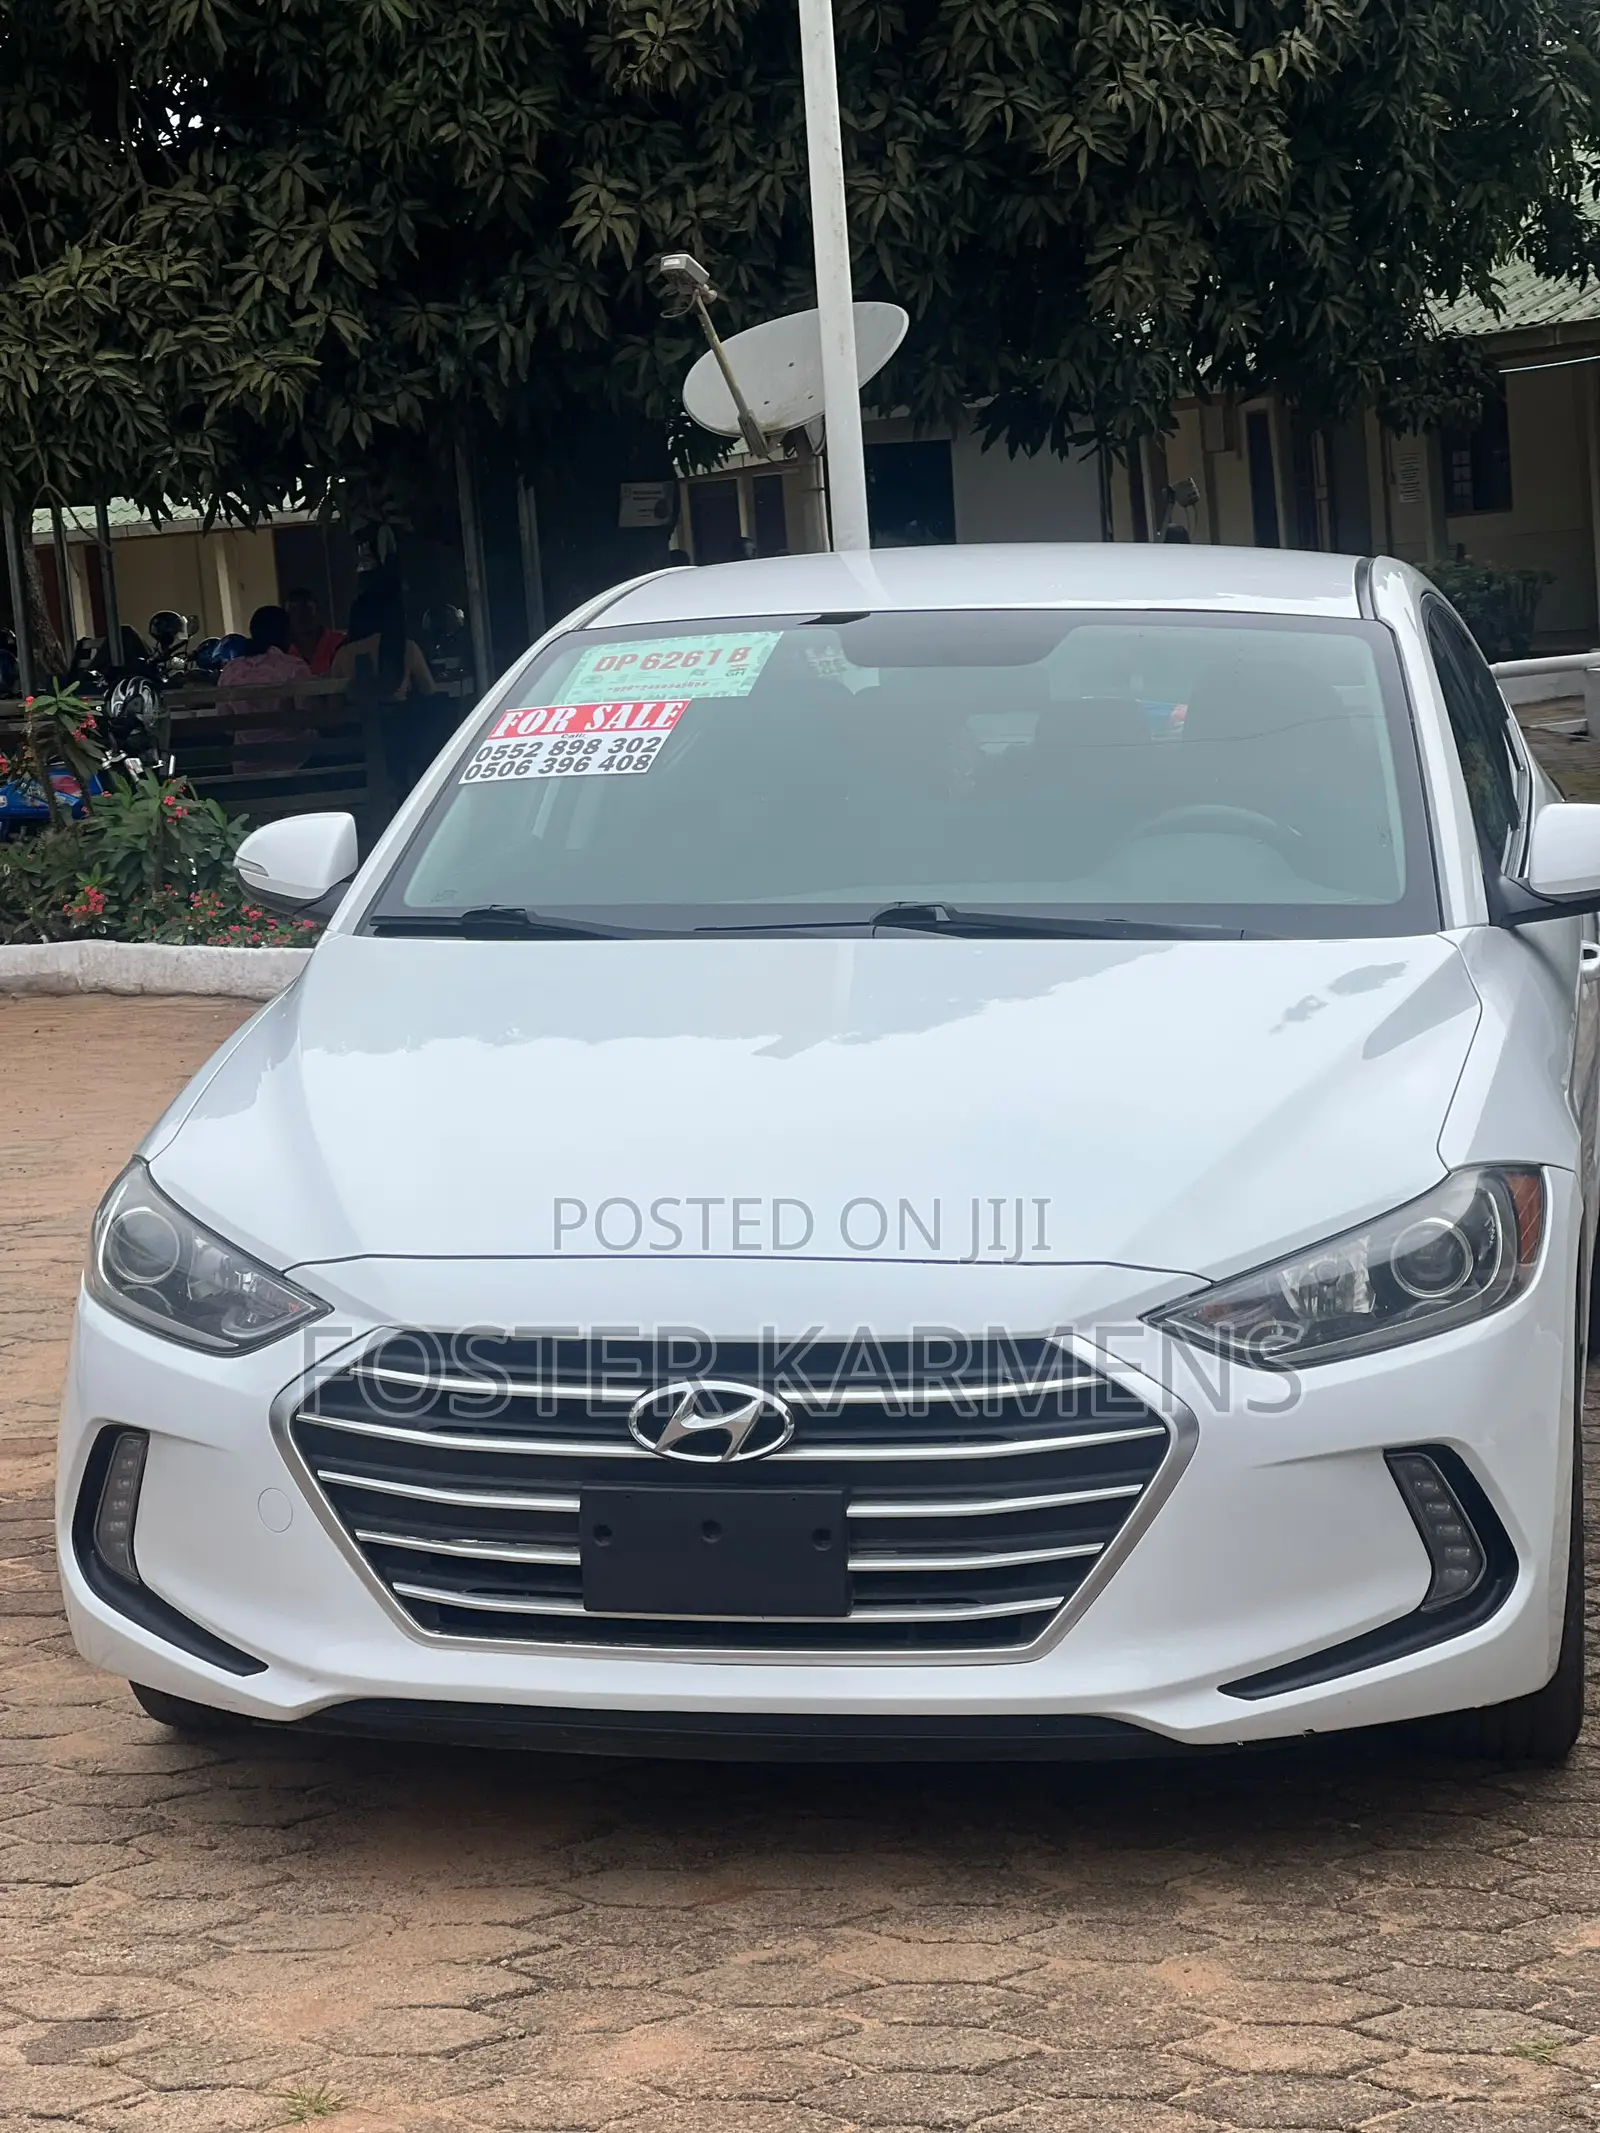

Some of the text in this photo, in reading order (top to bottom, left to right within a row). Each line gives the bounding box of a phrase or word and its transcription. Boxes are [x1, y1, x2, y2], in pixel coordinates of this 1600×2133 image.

[592, 647, 752, 672] DP 6261 B
[491, 702, 684, 738] FOR SALE
[475, 736, 662, 763] 0552 898 302
[464, 754, 652, 781] 0506 396 408
